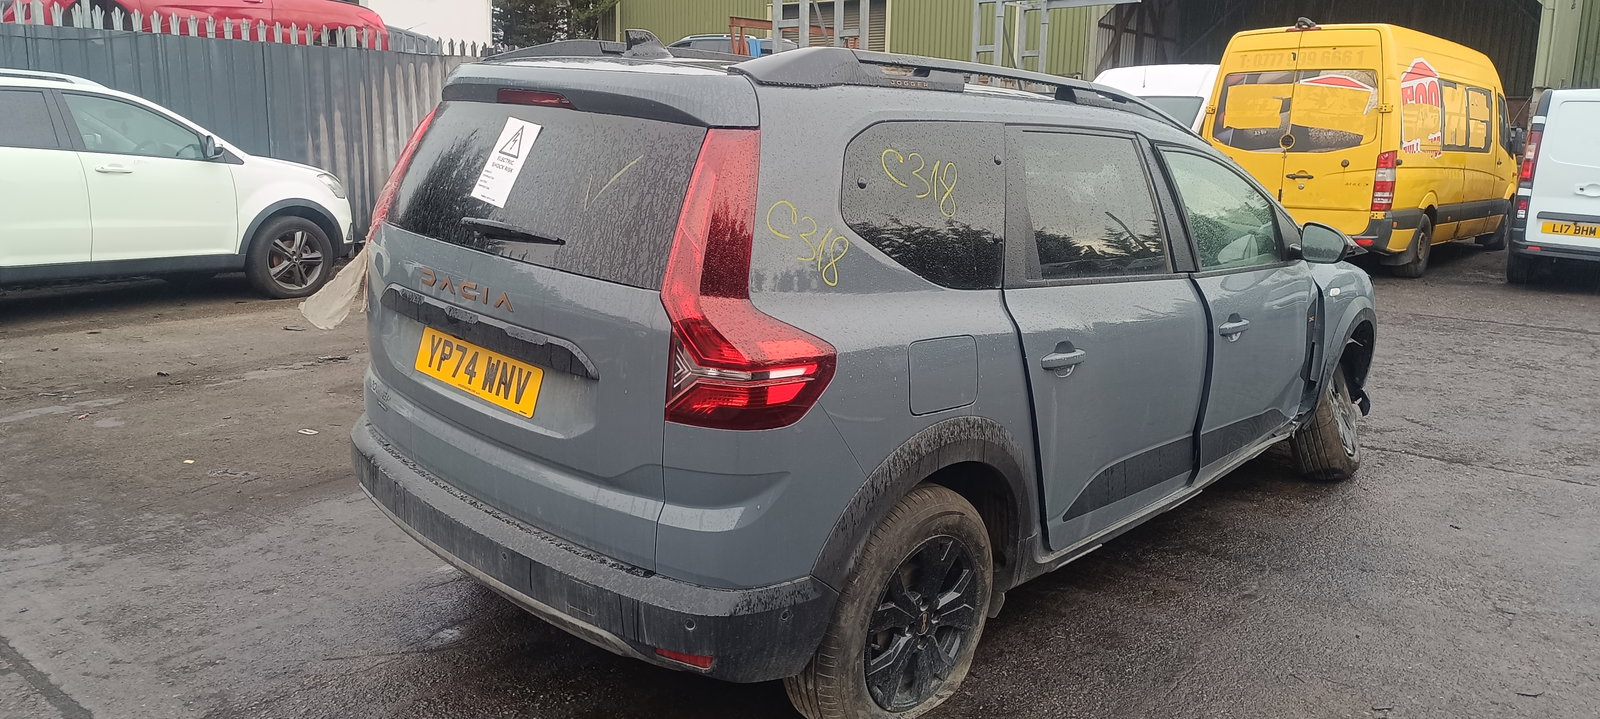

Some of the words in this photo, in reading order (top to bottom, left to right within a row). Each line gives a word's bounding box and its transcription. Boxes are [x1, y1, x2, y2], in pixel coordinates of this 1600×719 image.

[881, 148, 958, 218] C318
[766, 200, 849, 287] C318
[1552, 223, 1571, 234] L17
[1573, 225, 1597, 236] BHM
[420, 267, 515, 313] DACIA
[428, 334, 480, 386] YP74
[481, 355, 533, 406] WNV
